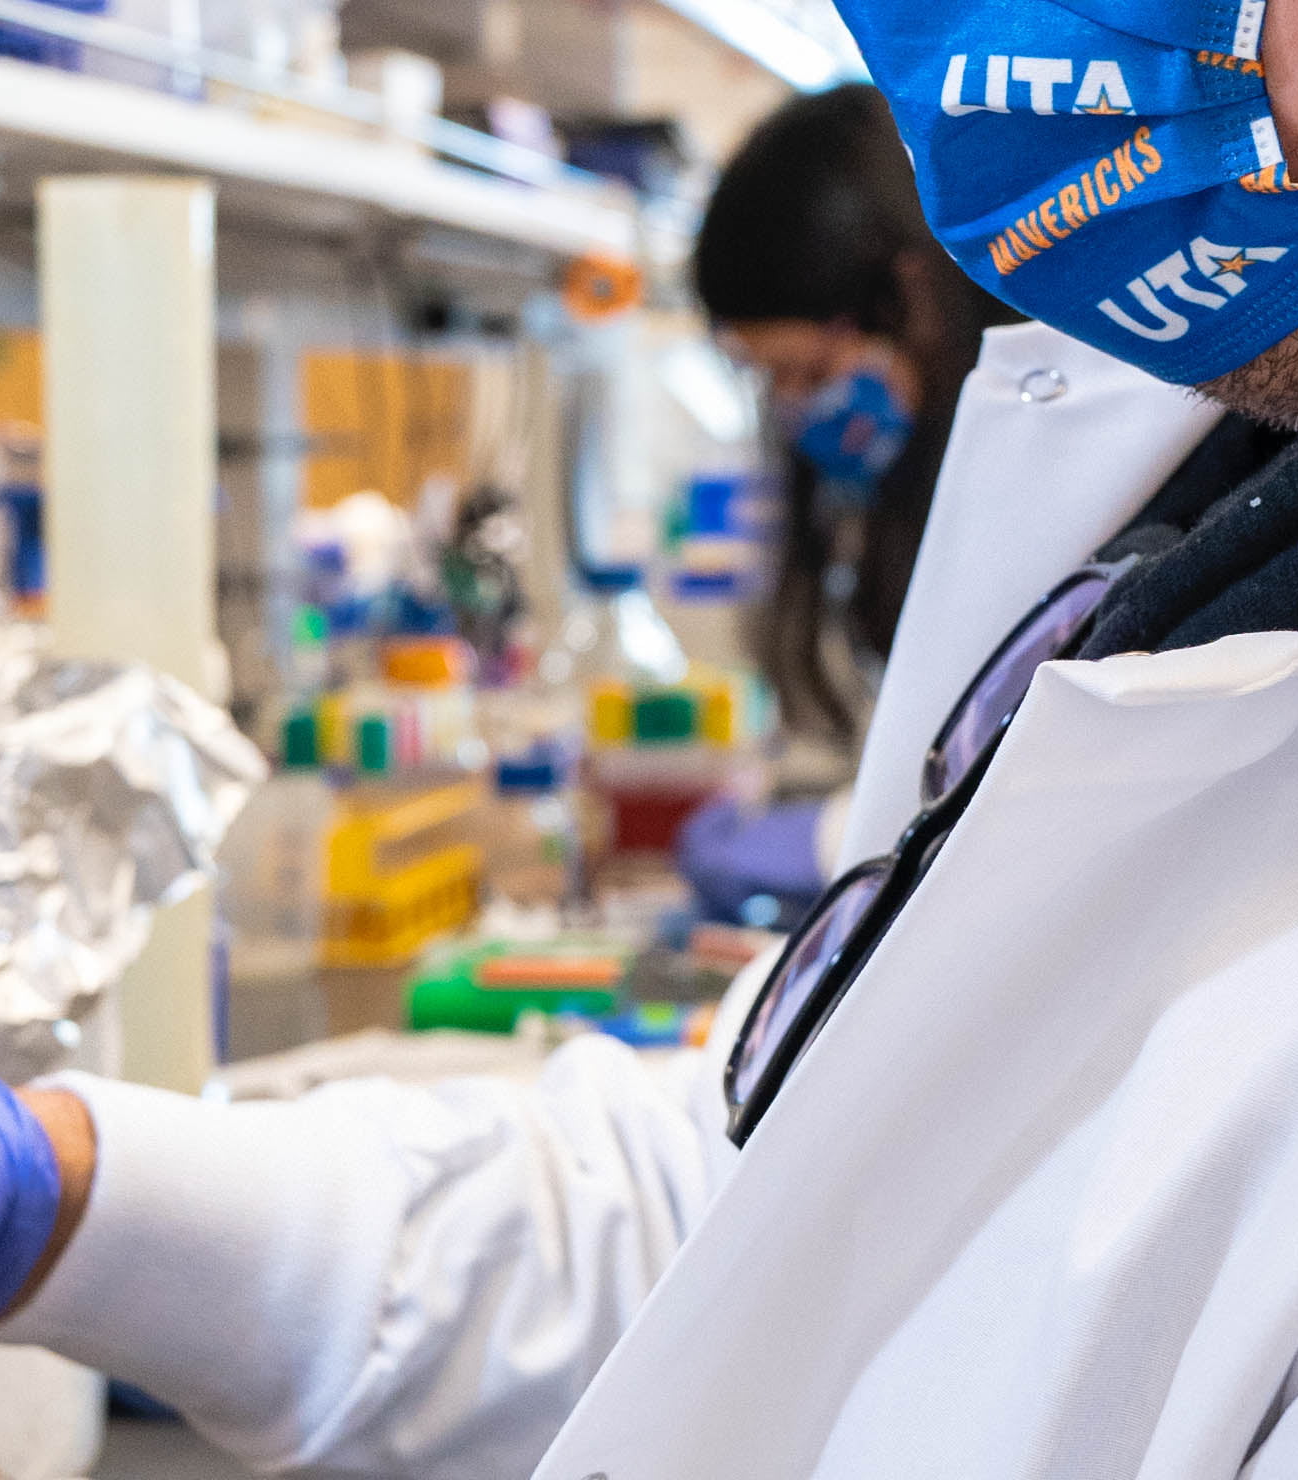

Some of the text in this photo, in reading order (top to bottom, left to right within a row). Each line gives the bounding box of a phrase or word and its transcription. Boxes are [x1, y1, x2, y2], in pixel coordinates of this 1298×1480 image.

[940, 54, 1138, 117] UTA
[988, 125, 1162, 276] MAVERICKS
[1097, 235, 1290, 343] UTA
